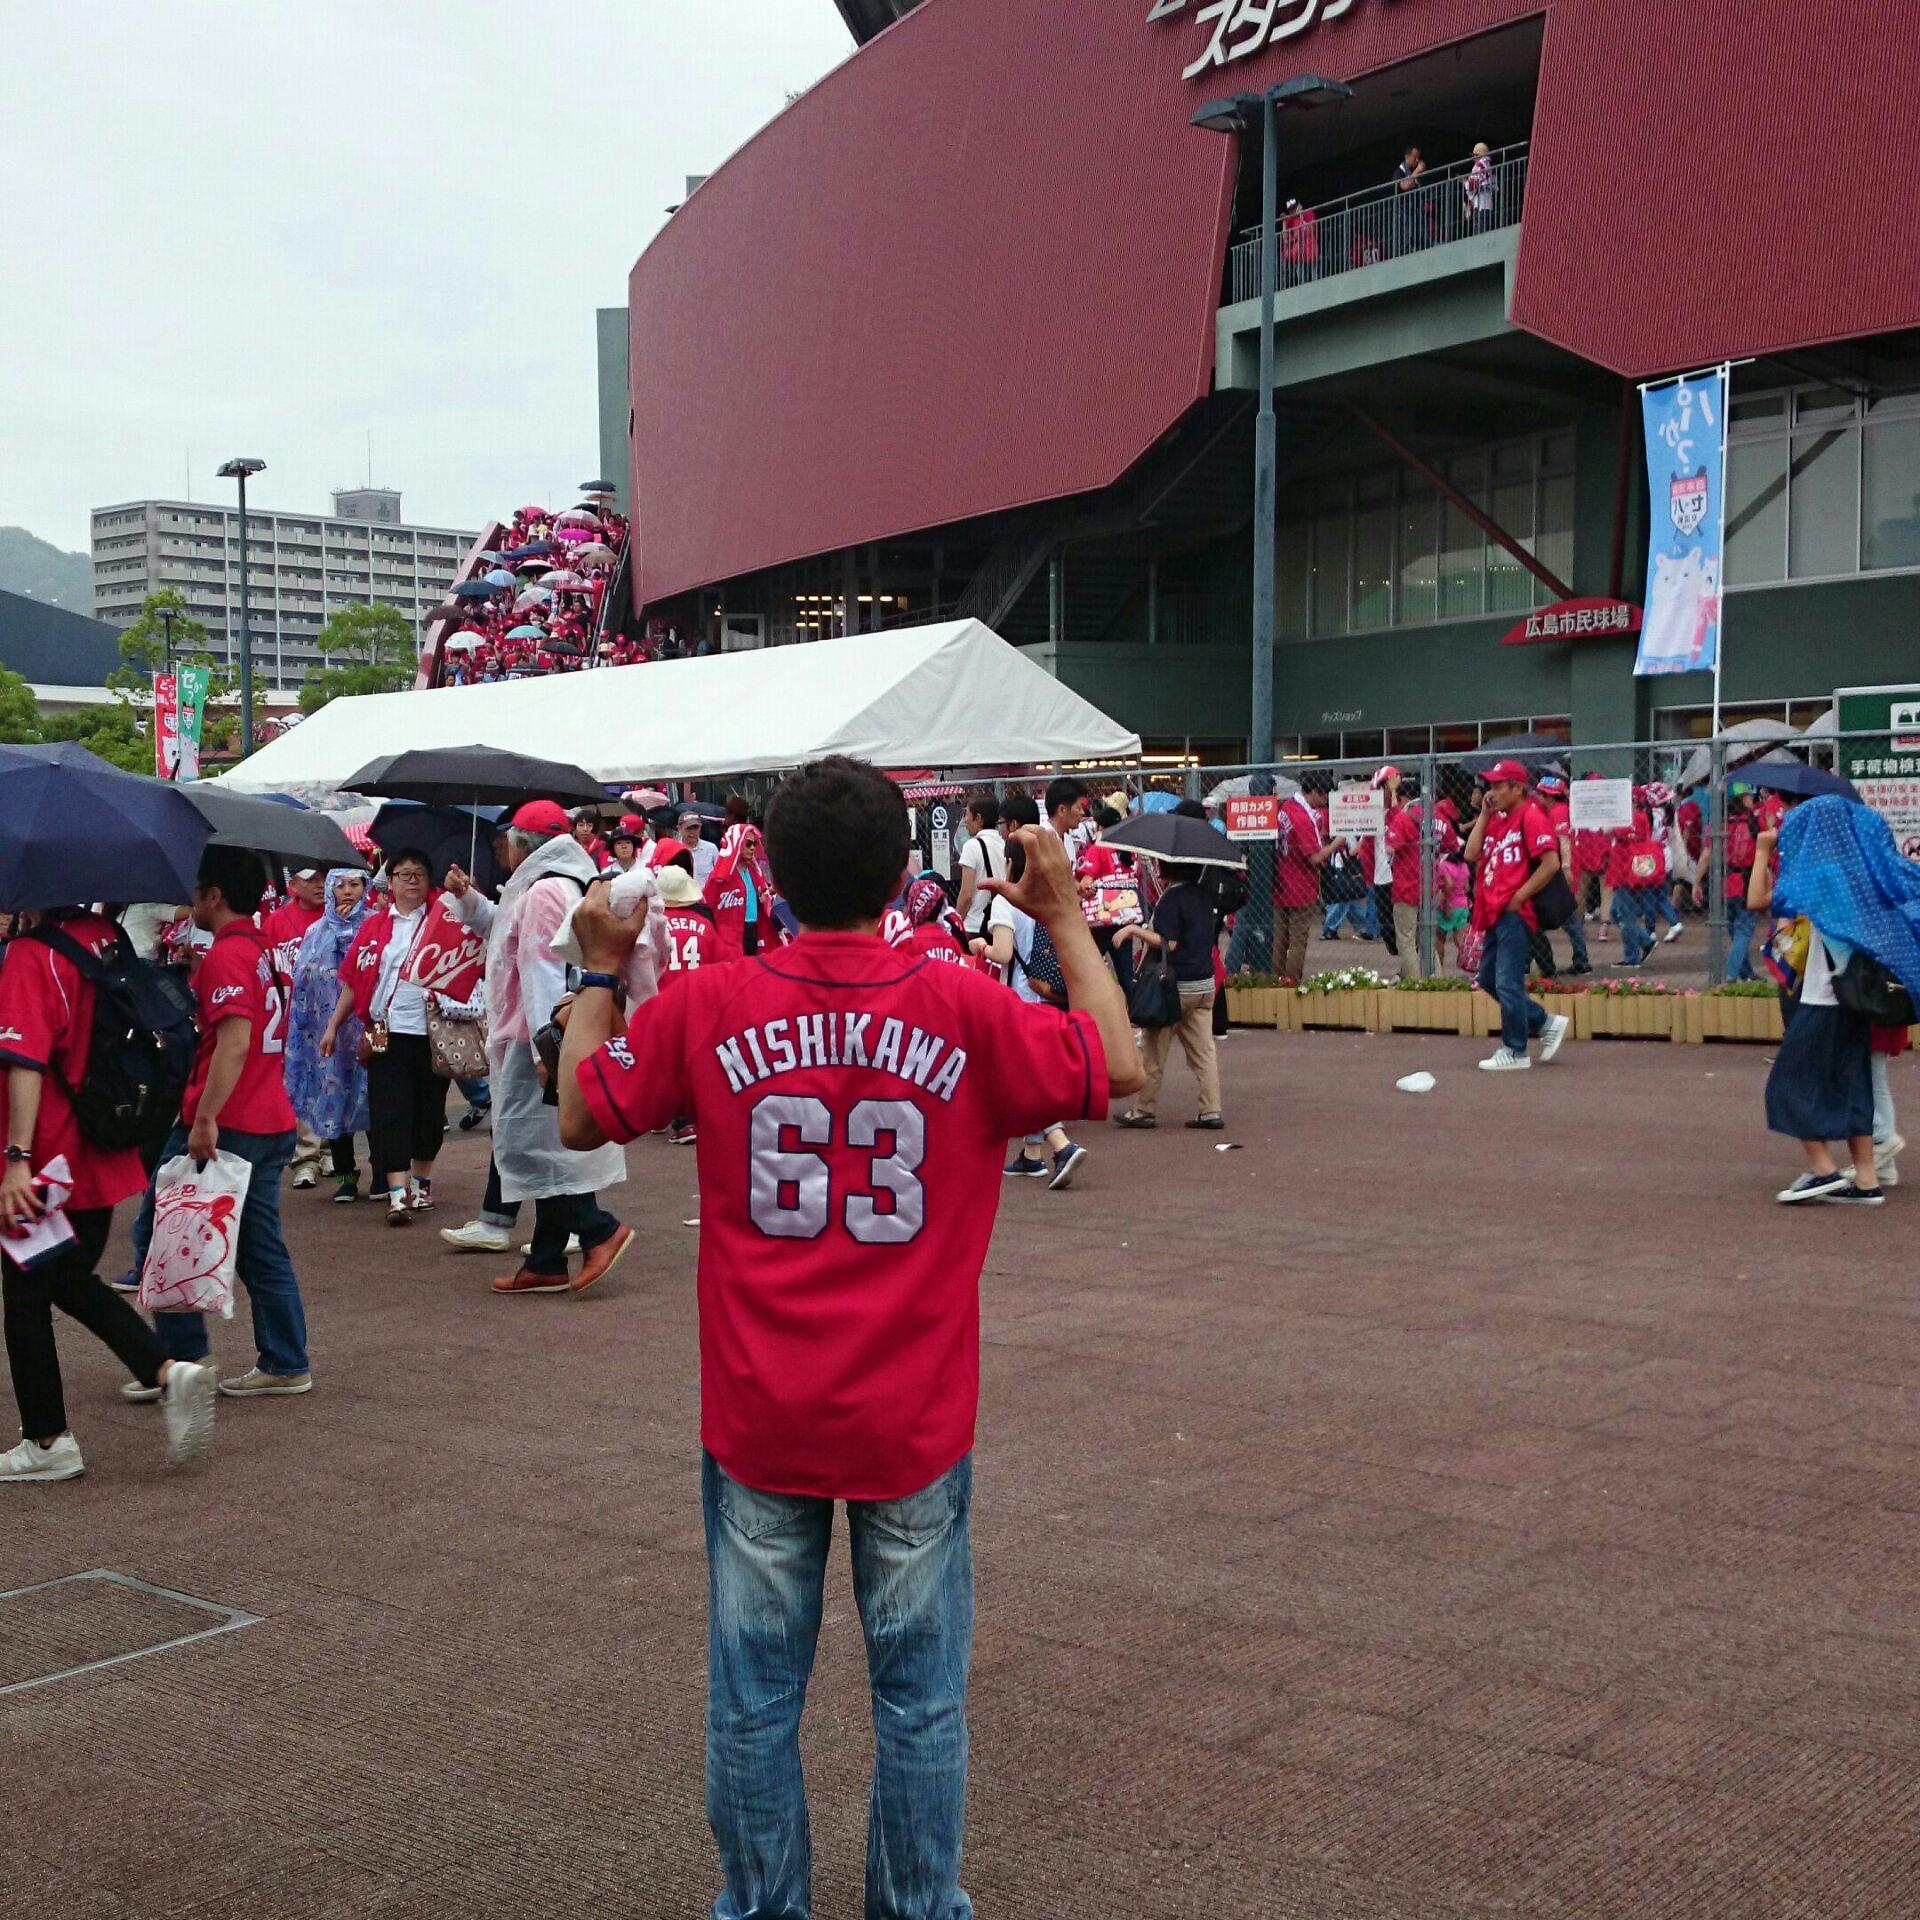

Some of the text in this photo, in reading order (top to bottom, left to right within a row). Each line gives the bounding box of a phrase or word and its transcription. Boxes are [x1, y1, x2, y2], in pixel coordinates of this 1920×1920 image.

[1525, 605, 1630, 638] 広島市民球場
[1231, 801, 1273, 814] 防犯カメラ
[1237, 814, 1268, 828] 作動中
[1502, 847, 1521, 864] 51
[669, 935, 701, 971] 14
[212, 984, 246, 1004] Carp
[715, 1011, 967, 1102] NISHIKAWA
[750, 1093, 926, 1244] 63
